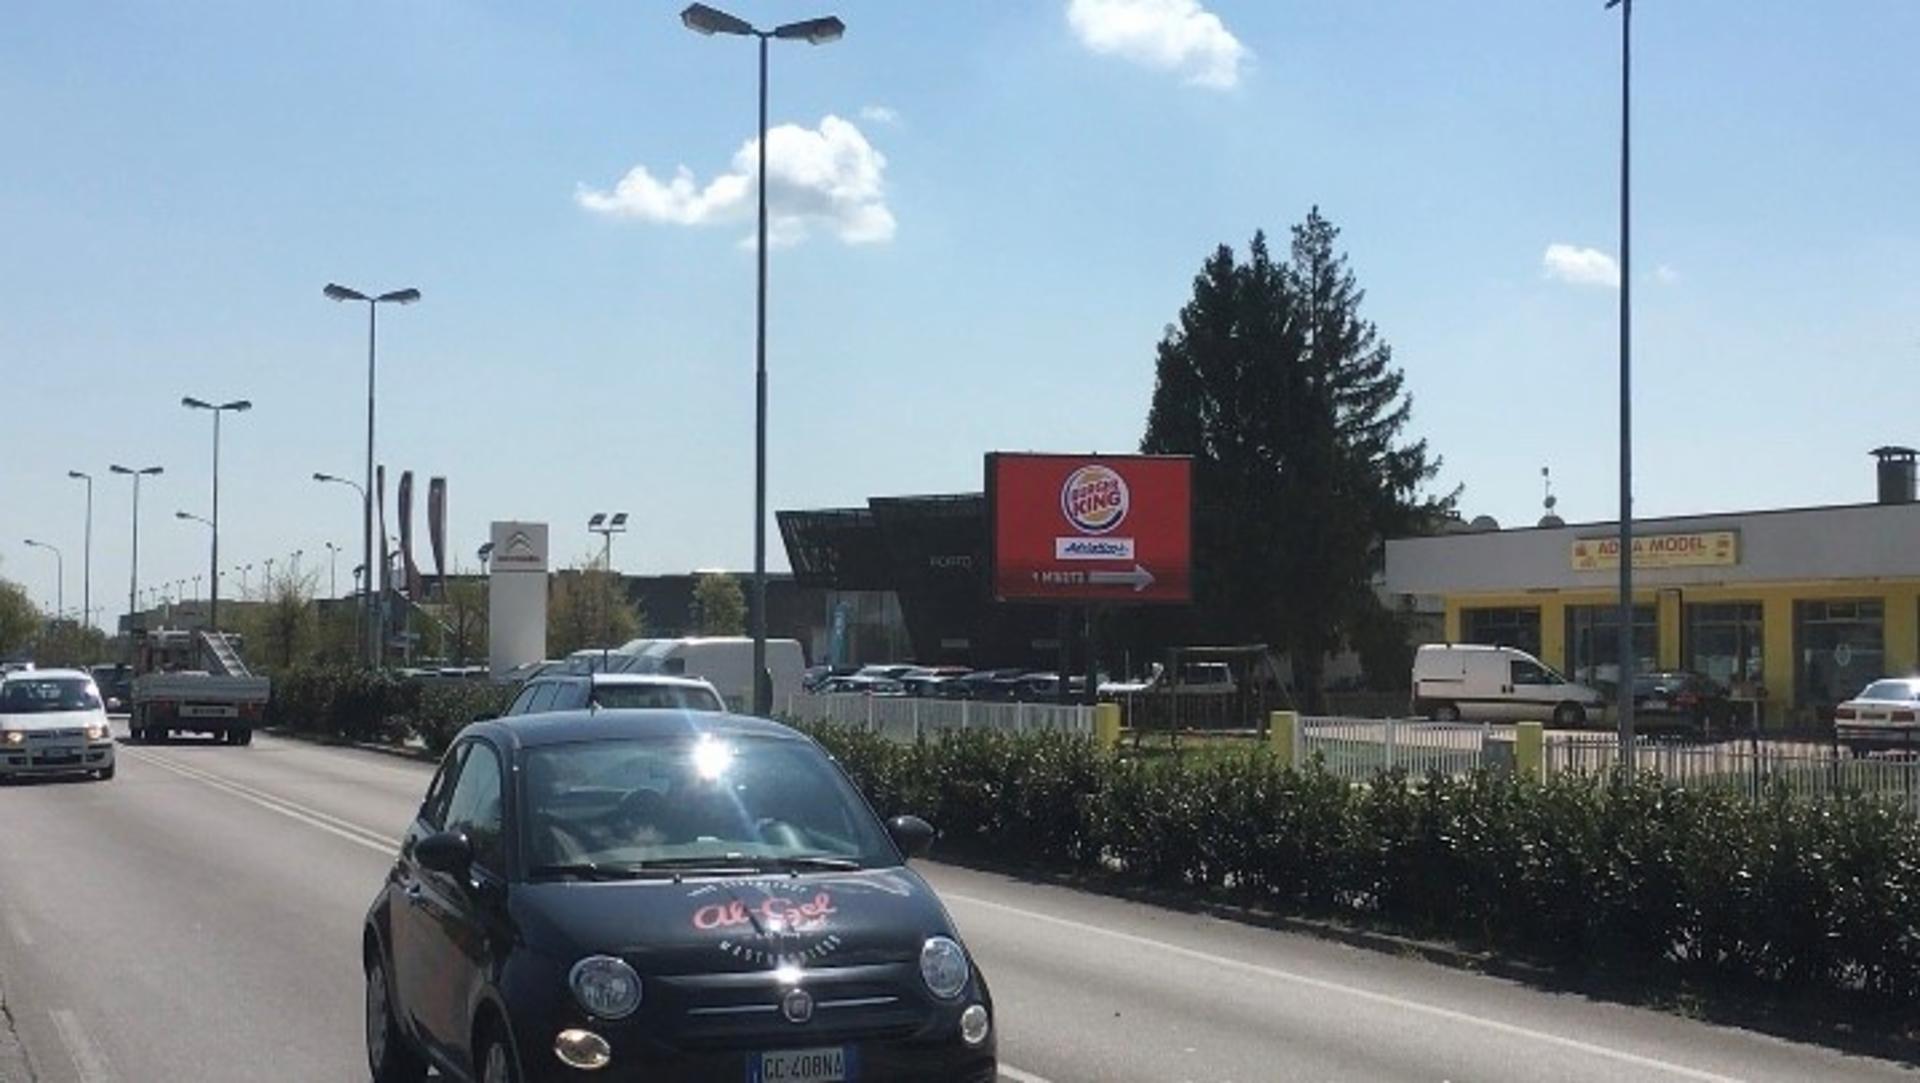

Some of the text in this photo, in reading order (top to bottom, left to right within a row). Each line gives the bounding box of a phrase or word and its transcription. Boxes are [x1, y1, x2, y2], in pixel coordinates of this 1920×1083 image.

[1072, 479, 1119, 501] BURGER
[1073, 491, 1121, 517] KING
[1649, 536, 1707, 552] MODEL
